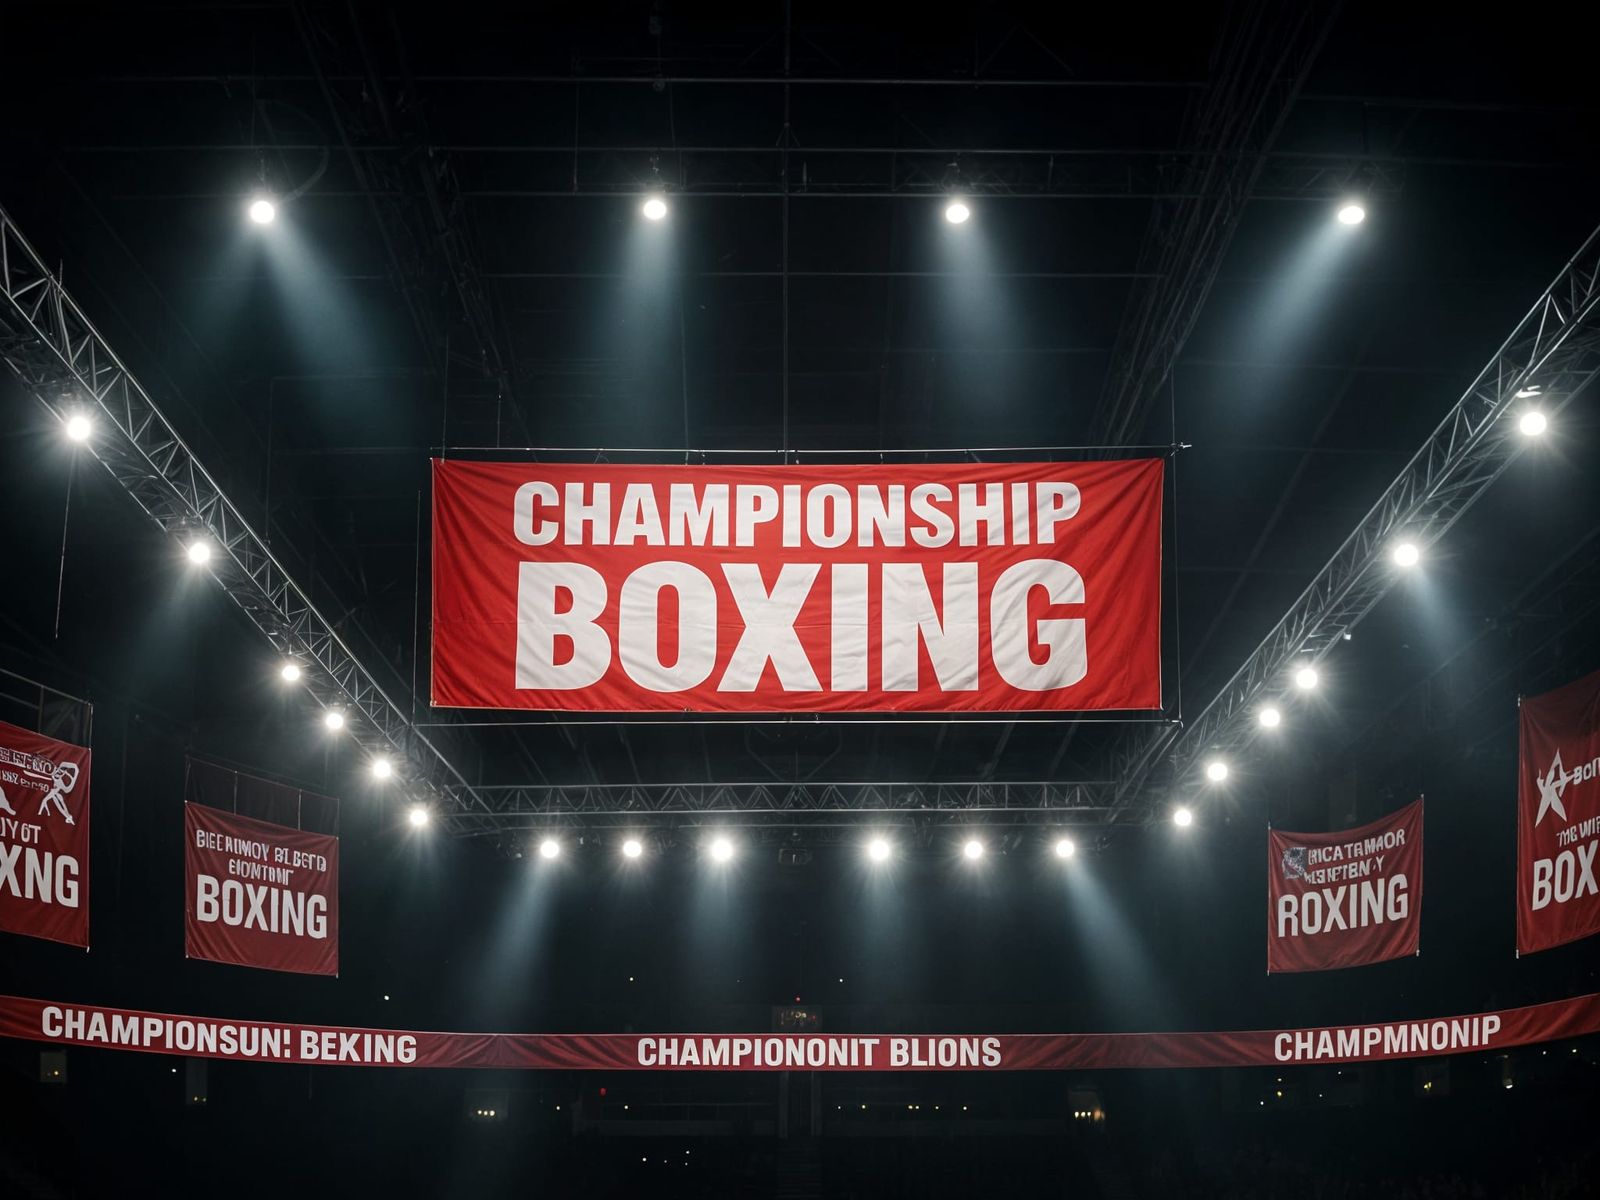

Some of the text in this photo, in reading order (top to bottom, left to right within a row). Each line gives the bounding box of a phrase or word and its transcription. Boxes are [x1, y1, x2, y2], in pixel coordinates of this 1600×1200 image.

[513, 481, 1082, 549] CHAMPIONSHIP
[515, 558, 1088, 693] BOXING
[196, 873, 328, 939] BOXING
[1277, 873, 1408, 938] ROXING
[1532, 838, 1599, 911] BOX
[42, 1006, 417, 1064] CHAMPIONSUN! BEKING
[637, 1037, 1002, 1067] CHAMPIONONIT BLIONS
[1274, 1015, 1501, 1062] CHAMPMNONIP
